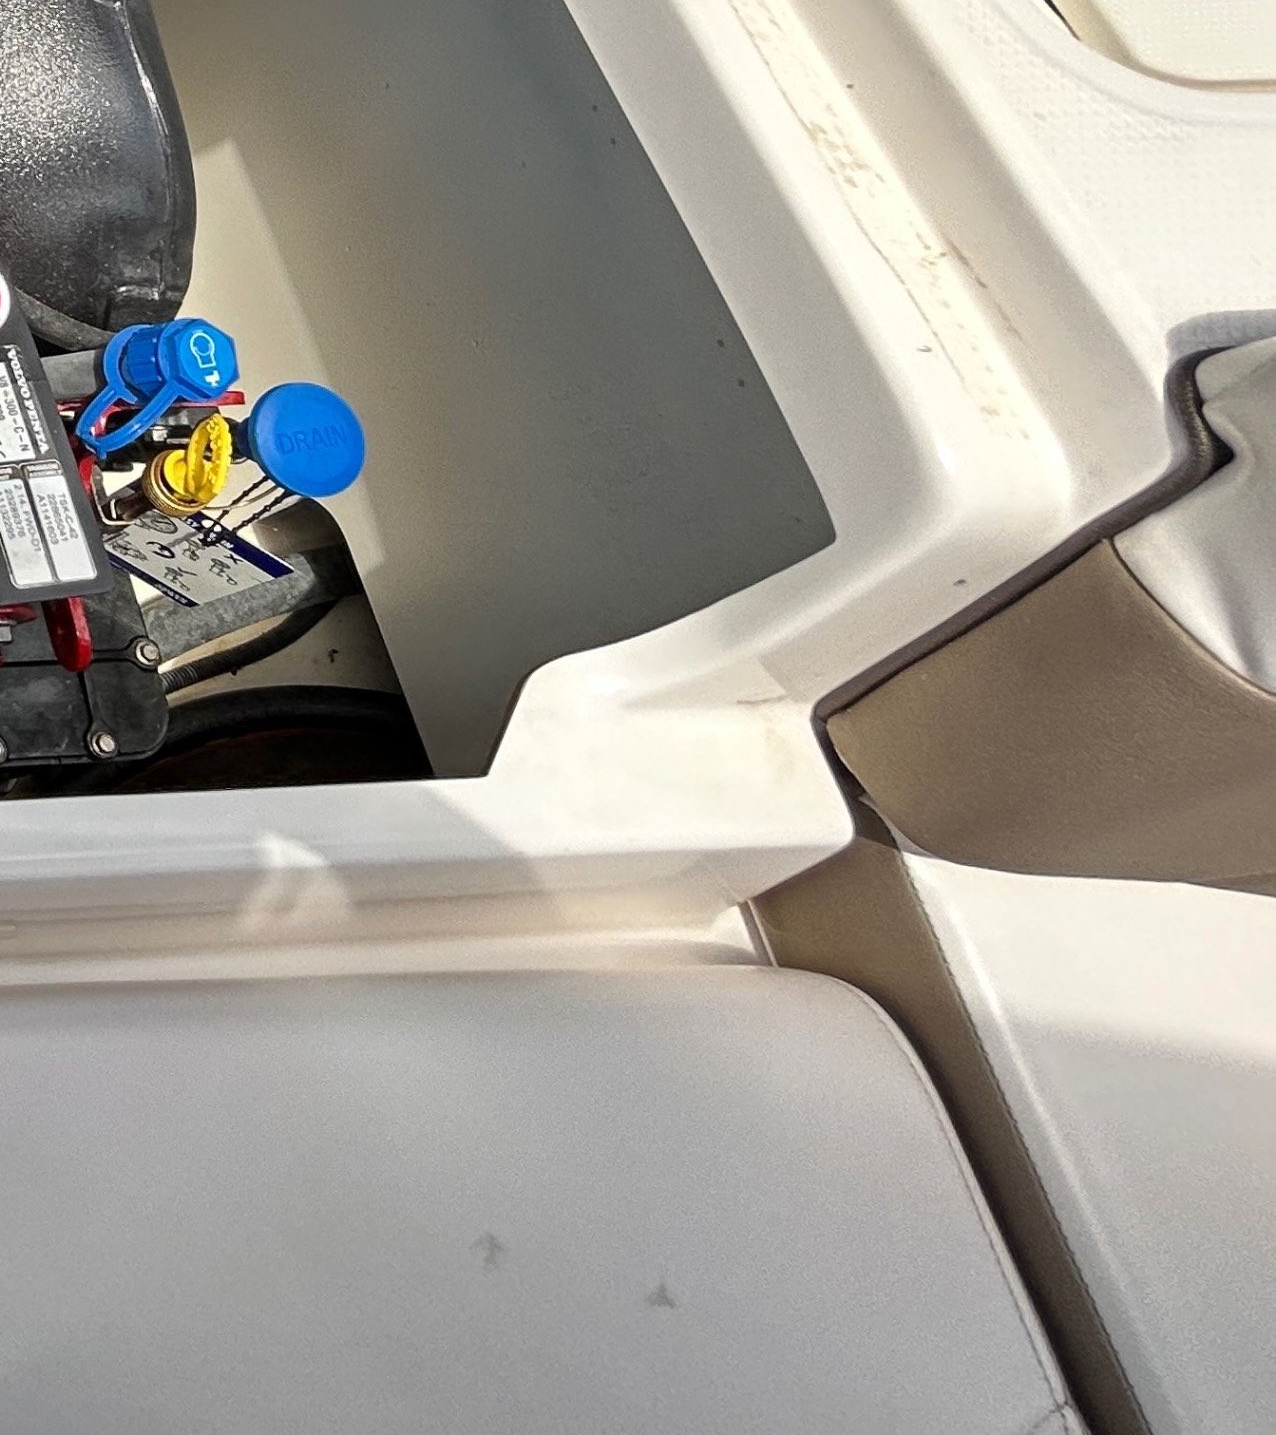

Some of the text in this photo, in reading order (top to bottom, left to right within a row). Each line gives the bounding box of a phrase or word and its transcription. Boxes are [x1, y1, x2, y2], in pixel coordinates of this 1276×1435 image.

[7, 348, 31, 398] VOLVO
[23, 399, 49, 454] PENTA
[276, 425, 347, 455] DRAIN
